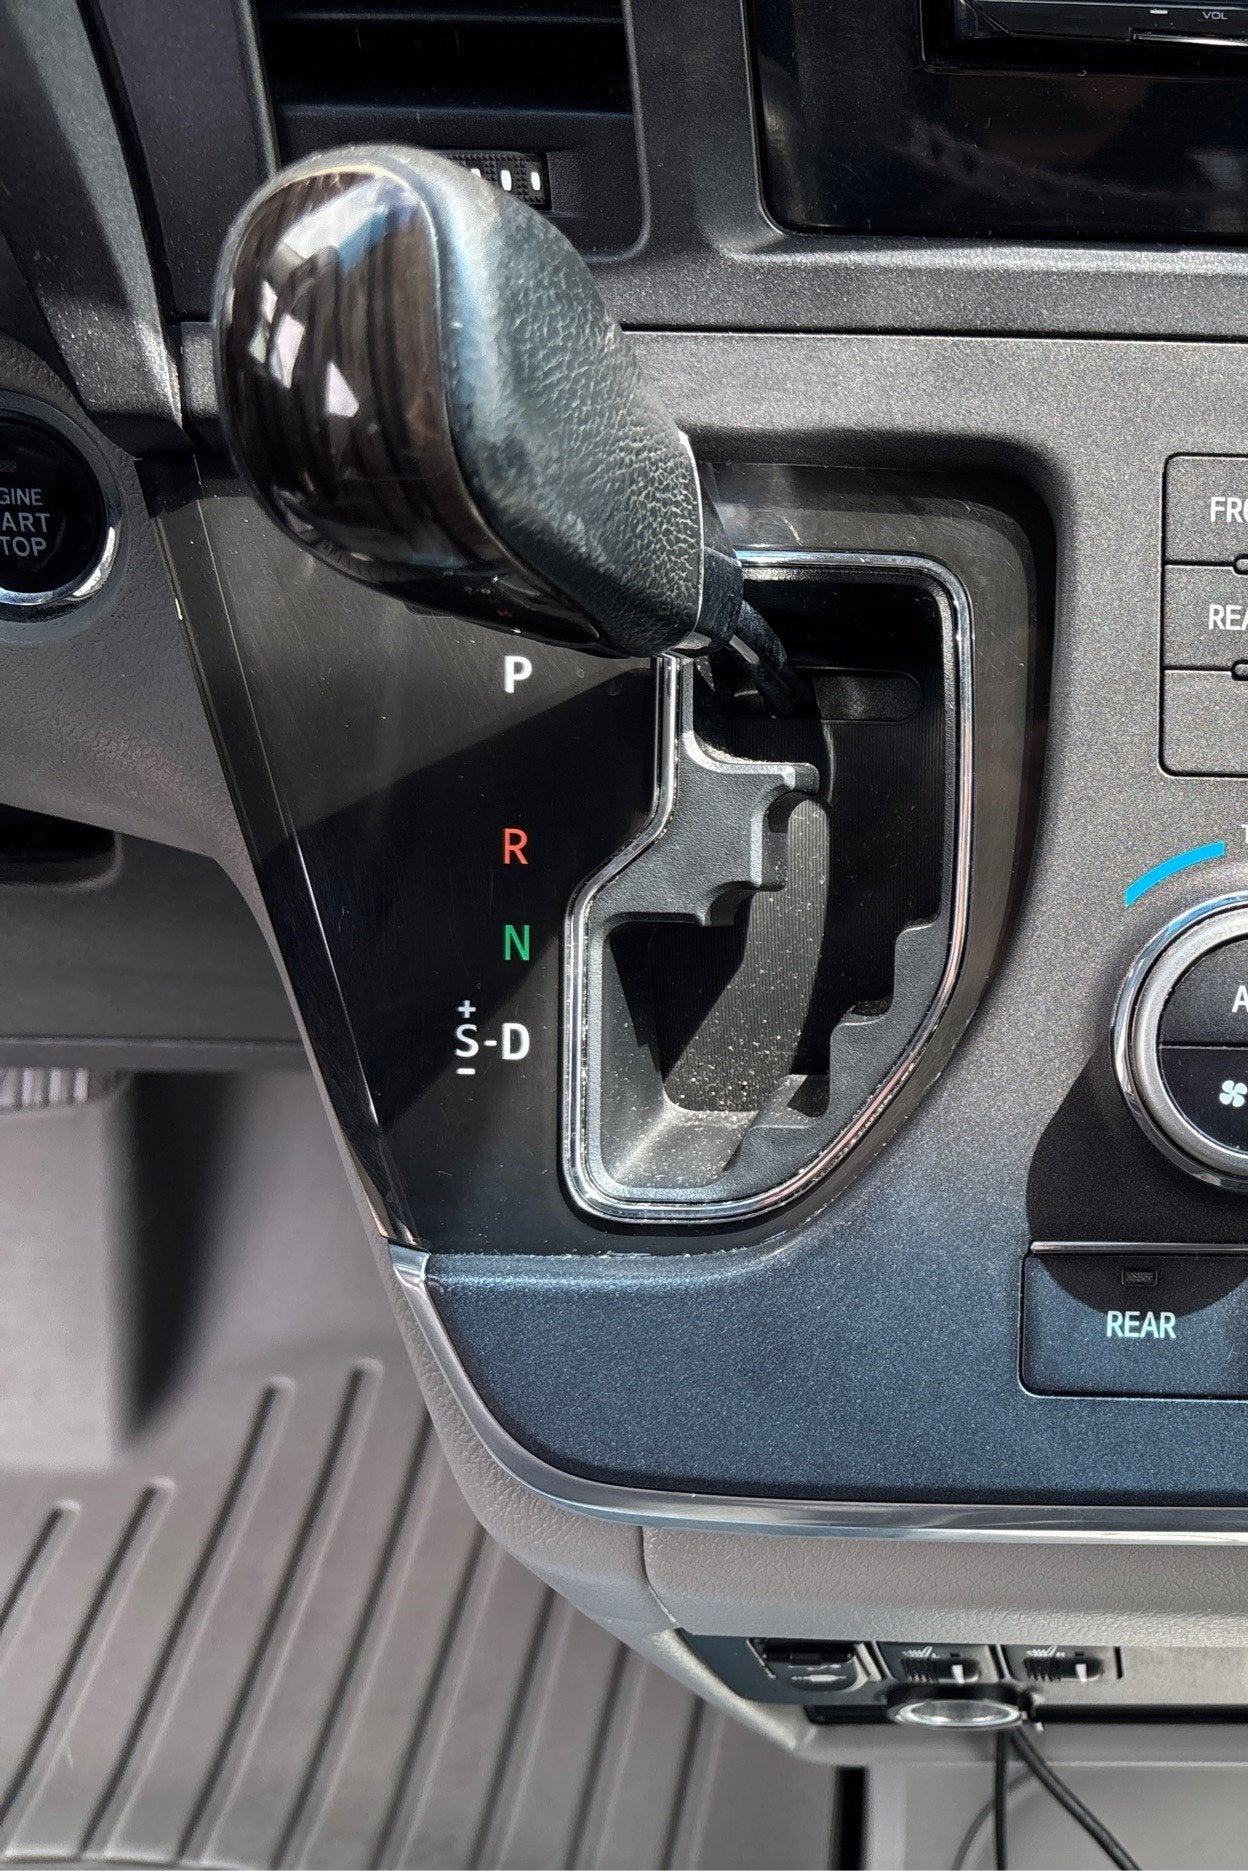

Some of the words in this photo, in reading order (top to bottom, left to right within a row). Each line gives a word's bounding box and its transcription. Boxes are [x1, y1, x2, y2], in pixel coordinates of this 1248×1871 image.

[1202, 11, 1228, 20] VOL
[2, 511, 50, 533] ART
[503, 656, 533, 694] P
[504, 828, 529, 864] R
[504, 924, 530, 961] N
[1106, 1310, 1177, 1340] REAR
